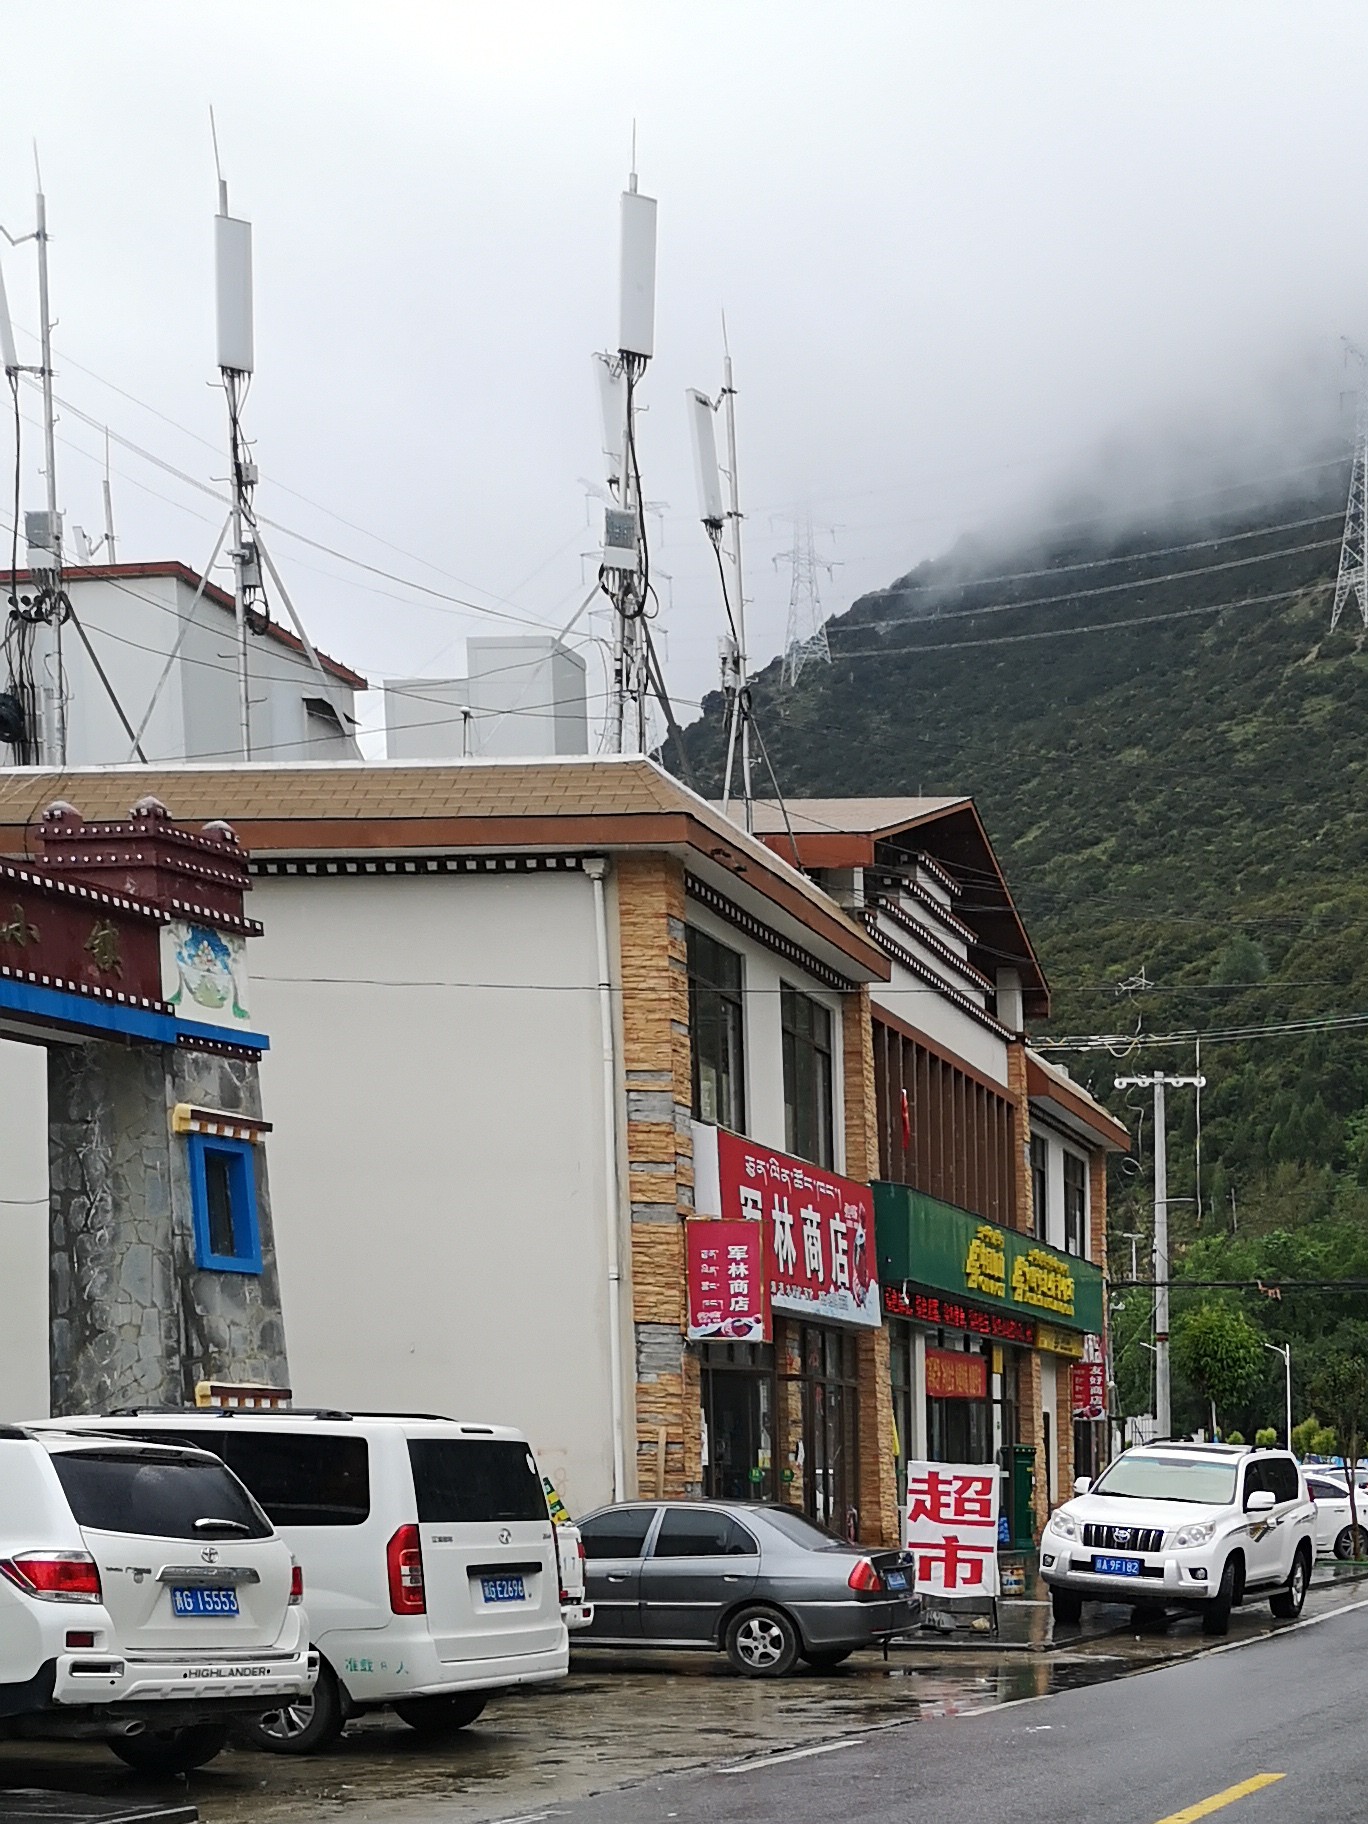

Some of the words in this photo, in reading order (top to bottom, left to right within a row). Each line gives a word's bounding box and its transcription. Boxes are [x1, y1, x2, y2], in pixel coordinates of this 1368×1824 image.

[726, 1244, 750, 1312] 军林商店
[1089, 1365, 1103, 1405] 友好商店
[907, 1470, 996, 1589] 超市
[188, 1666, 267, 1679] HIGHLANDER
